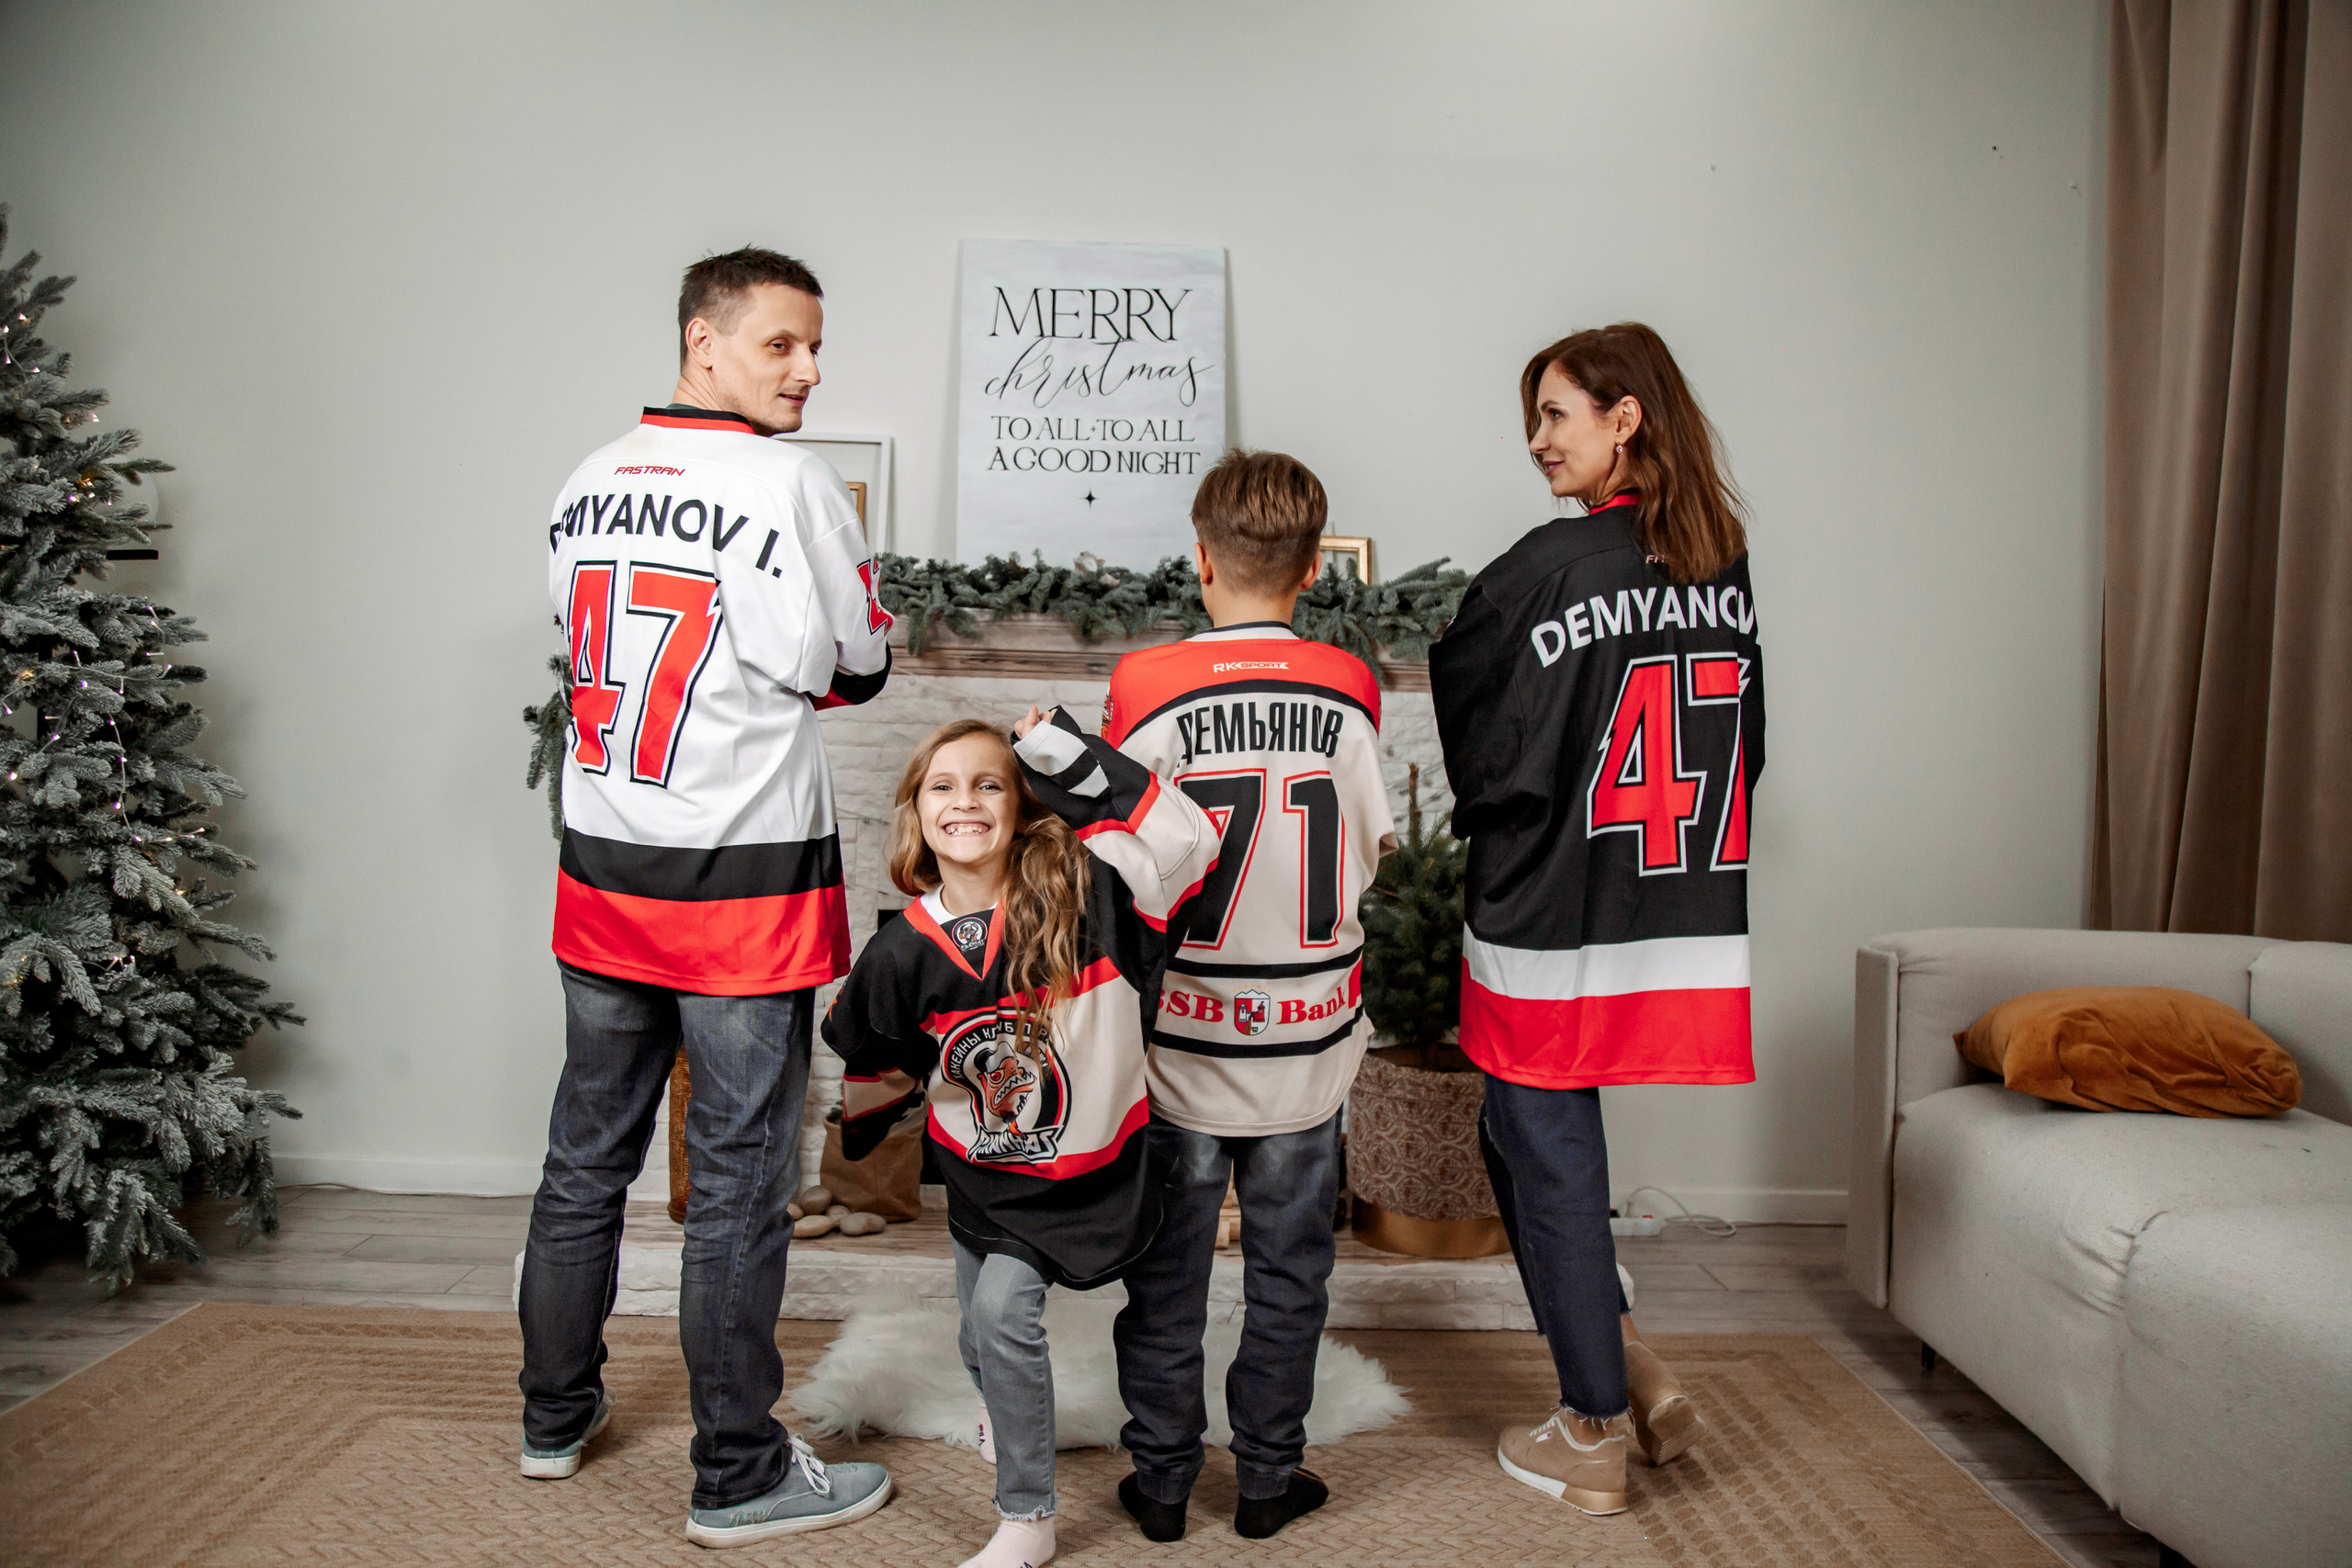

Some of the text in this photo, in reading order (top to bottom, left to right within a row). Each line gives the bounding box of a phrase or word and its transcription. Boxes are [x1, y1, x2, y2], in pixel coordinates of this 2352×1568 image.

[988, 286, 1194, 344] MERRY
[985, 334, 1216, 409] christmas
[990, 416, 1196, 443] TO ALL TO ALL
[614, 465, 685, 477] FASTRAN
[987, 446, 1202, 475] A GOOD NIGHT
[566, 558, 725, 790] 47
[1587, 652, 1751, 877] 47
[1174, 768, 1346, 952] 71
[1159, 986, 1346, 1025] SB Bank
